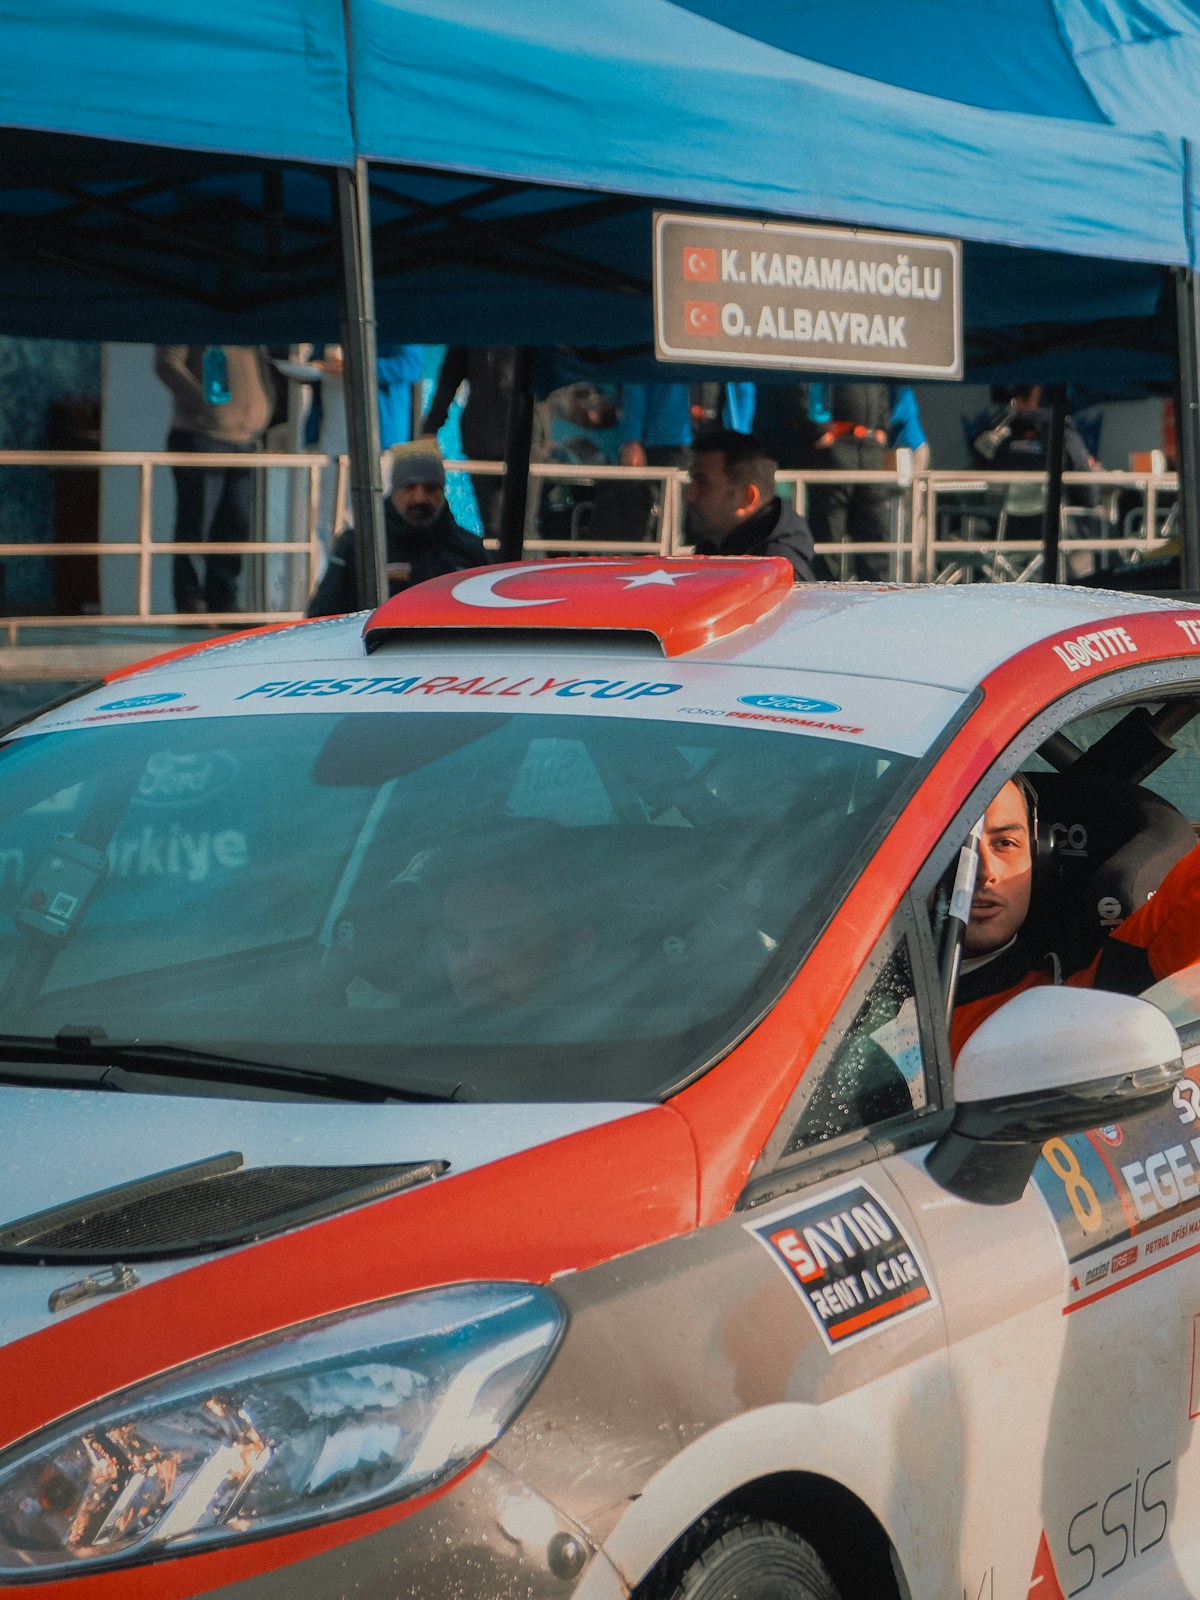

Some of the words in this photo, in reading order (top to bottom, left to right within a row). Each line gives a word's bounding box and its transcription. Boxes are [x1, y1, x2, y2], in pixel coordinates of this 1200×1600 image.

[721, 249, 747, 283] K.
[750, 251, 942, 301] KARAMANOĞLU
[720, 303, 752, 337] O.
[756, 305, 907, 349] ALBAYRAK
[1052, 626, 1138, 672] LOCTITE
[1041, 1136, 1102, 1232] 8
[1144, 1234, 1170, 1256] PETROL
[809, 1273, 864, 1320] RENT
[876, 1251, 920, 1291] CAR
